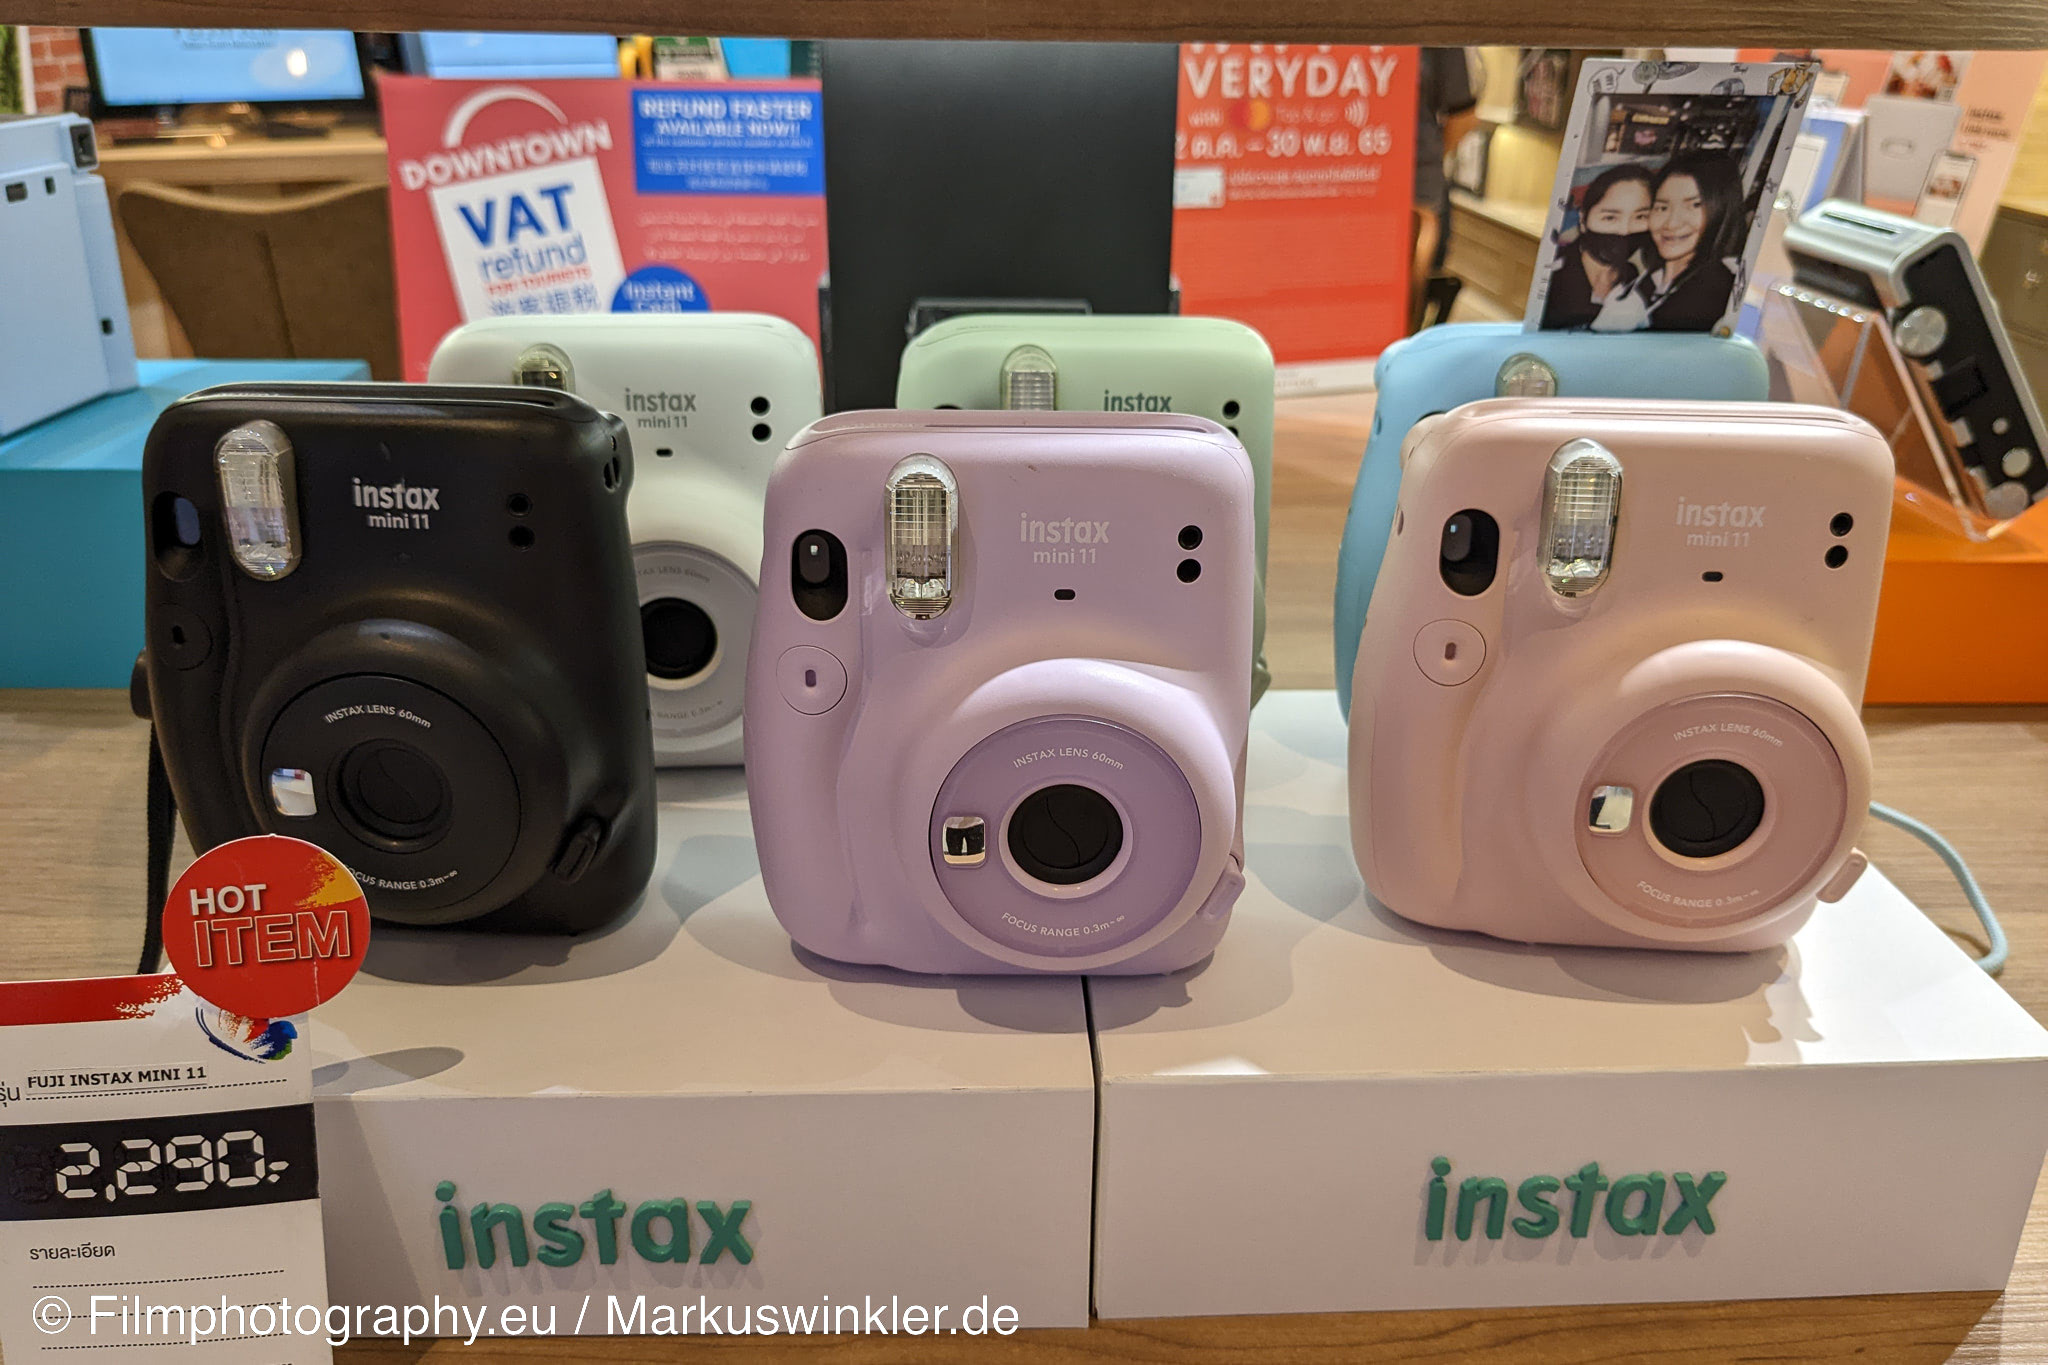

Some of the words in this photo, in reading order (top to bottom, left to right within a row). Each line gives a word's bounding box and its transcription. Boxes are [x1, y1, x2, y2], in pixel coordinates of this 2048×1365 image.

[638, 95, 727, 118] REFUND
[729, 95, 812, 120] FASTER
[653, 120, 743, 137] AVAILABLE
[401, 118, 613, 190] DOWNTOWN
[458, 183, 573, 246] VAT
[480, 233, 587, 281] refund
[625, 388, 696, 412] instax
[1103, 389, 1171, 412] instax
[352, 477, 440, 511] instax
[1676, 496, 1766, 528] instax
[1020, 512, 1110, 543] instax
[324, 704, 365, 724] INSTAX
[368, 704, 396, 715] LENS
[399, 708, 432, 729] 60mm
[1673, 724, 1717, 741] INSTAX
[1720, 723, 1750, 734] LENS
[1752, 728, 1783, 747] 60mm
[1013, 749, 1055, 768] INSTAX
[1059, 747, 1089, 758] LENS
[1091, 752, 1124, 770] 60mm
[378, 879, 418, 890] RANGE
[1636, 880, 1670, 902] FOCUS
[1673, 896, 1712, 908] RANGE
[189, 883, 267, 916] HOT
[1001, 912, 1038, 933] FOCUS
[1040, 926, 1080, 937] RANGE
[194, 910, 351, 967] ITEM
[28, 1074, 65, 1089] FUJI
[70, 1071, 132, 1086] INSTAX
[138, 1068, 181, 1083] MINI
[187, 1066, 207, 1079] 11
[1425, 1156, 1727, 1241] instax
[435, 1181, 755, 1270] instax
[29, 1242, 116, 1260] รายละเอียด
